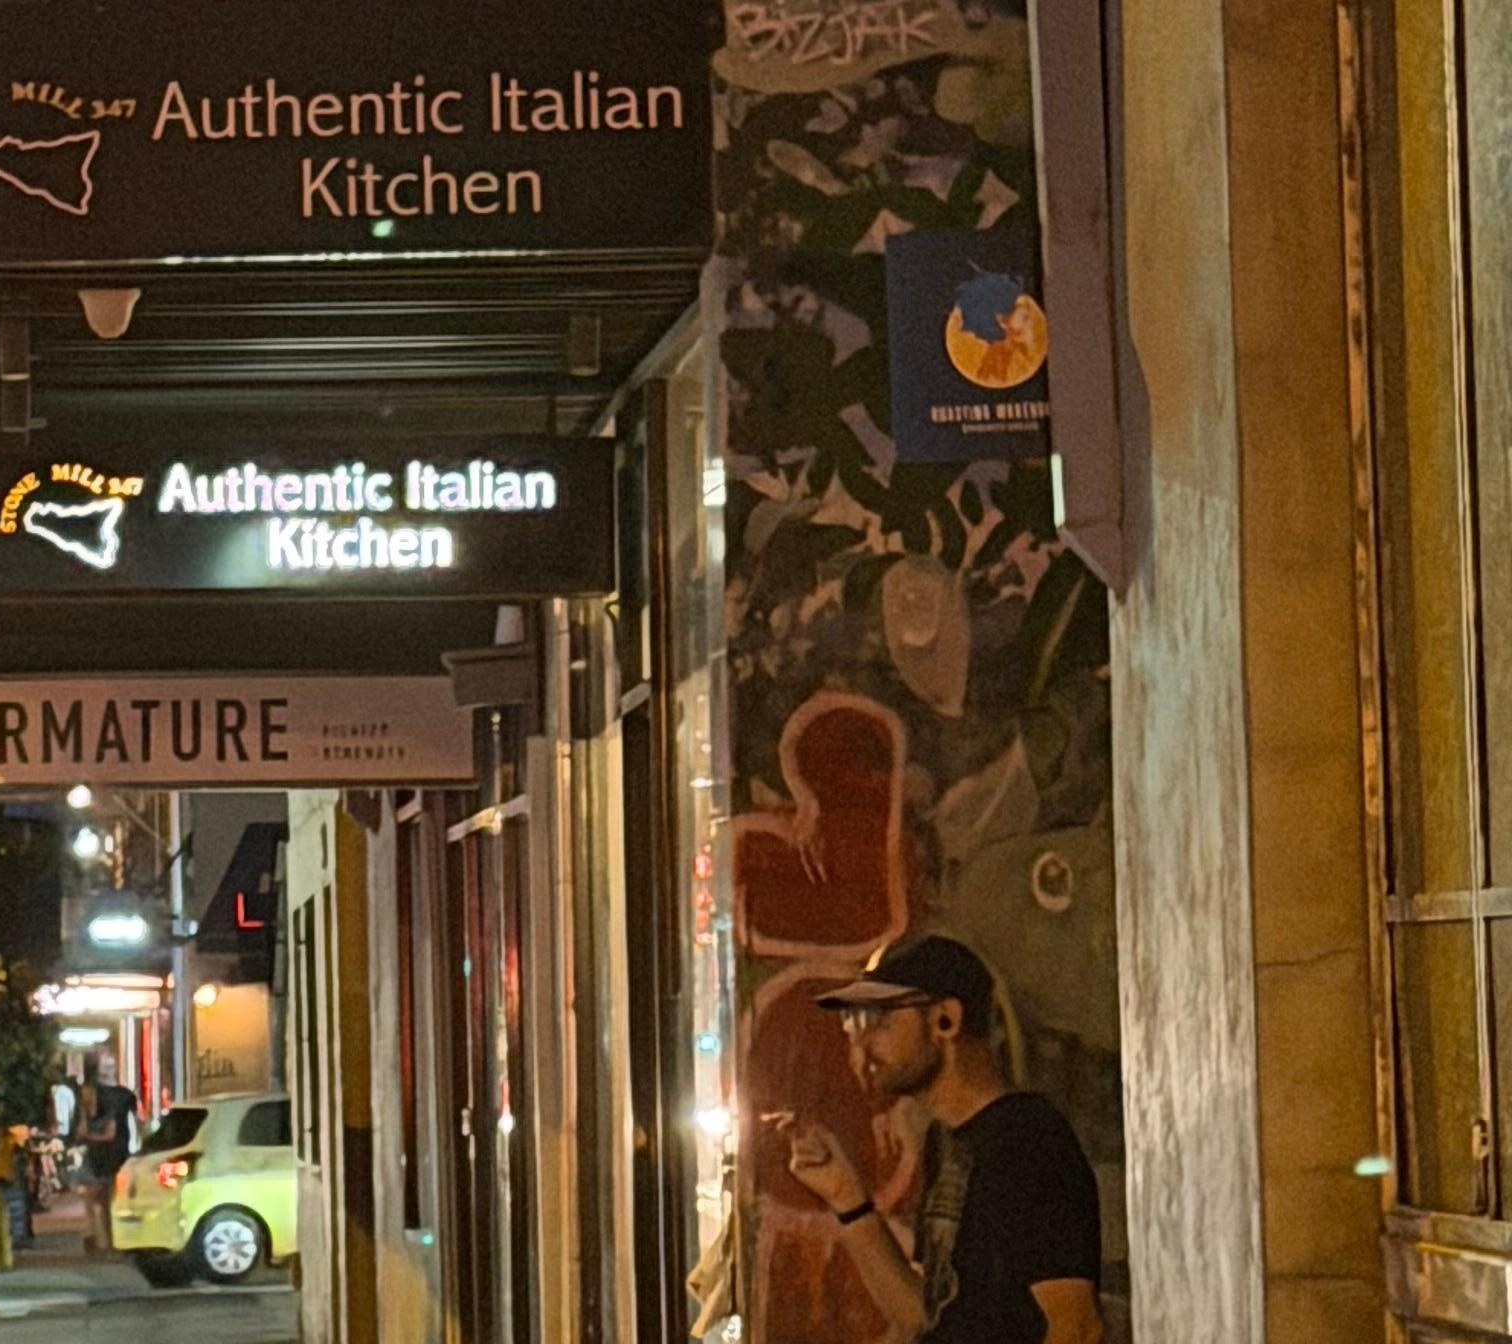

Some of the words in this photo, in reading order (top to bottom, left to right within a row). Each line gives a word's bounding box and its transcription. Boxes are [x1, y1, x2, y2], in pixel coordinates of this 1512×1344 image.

[10, 81, 85, 120] MILL
[150, 73, 464, 141] Authentic
[490, 69, 684, 133] Italian
[301, 154, 542, 218] Kitchen
[50, 462, 106, 495] MILL
[157, 461, 393, 514] Authentic
[405, 459, 557, 512] Italian
[267, 514, 454, 570] Kitchen
